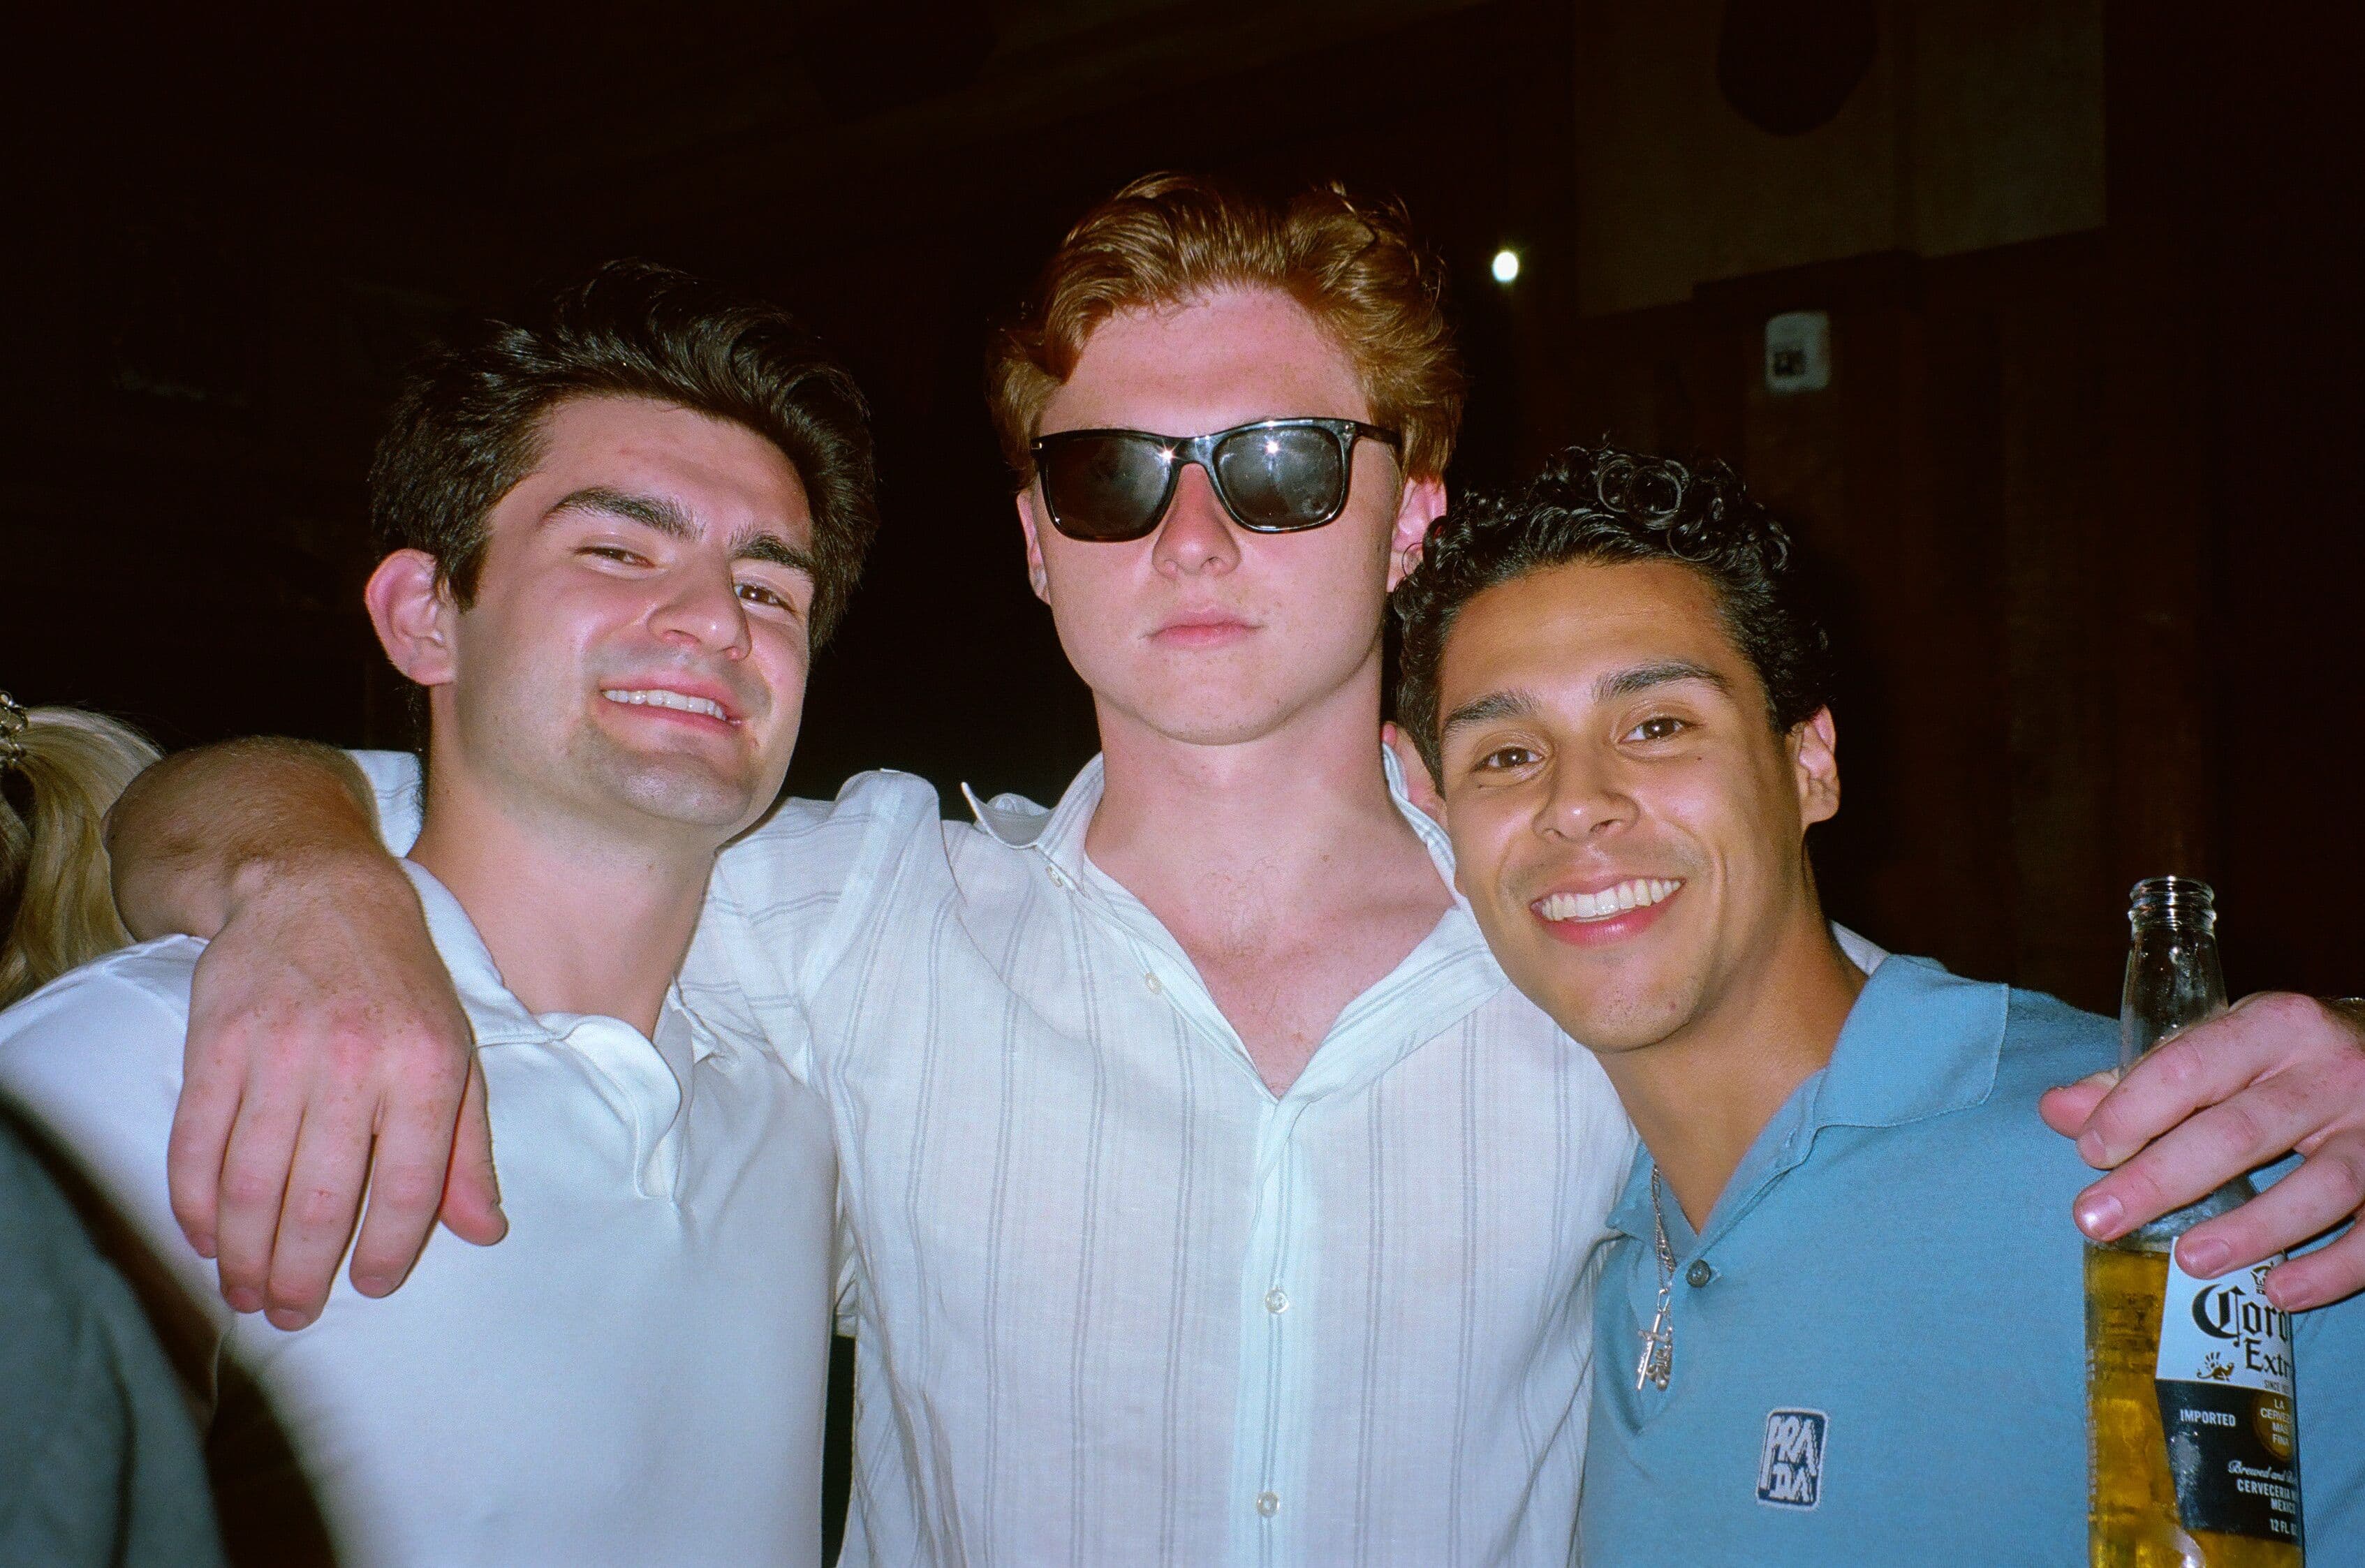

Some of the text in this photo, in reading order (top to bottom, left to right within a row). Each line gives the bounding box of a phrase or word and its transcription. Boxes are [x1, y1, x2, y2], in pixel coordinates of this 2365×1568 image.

[2274, 1398, 2285, 1410] LA
[2180, 1409, 2236, 1427] IMPORTED
[2227, 1460, 2271, 1479] Brewed
[2237, 1479, 2290, 1500] CERVECERIA
[2269, 1518, 2280, 1532] 12
